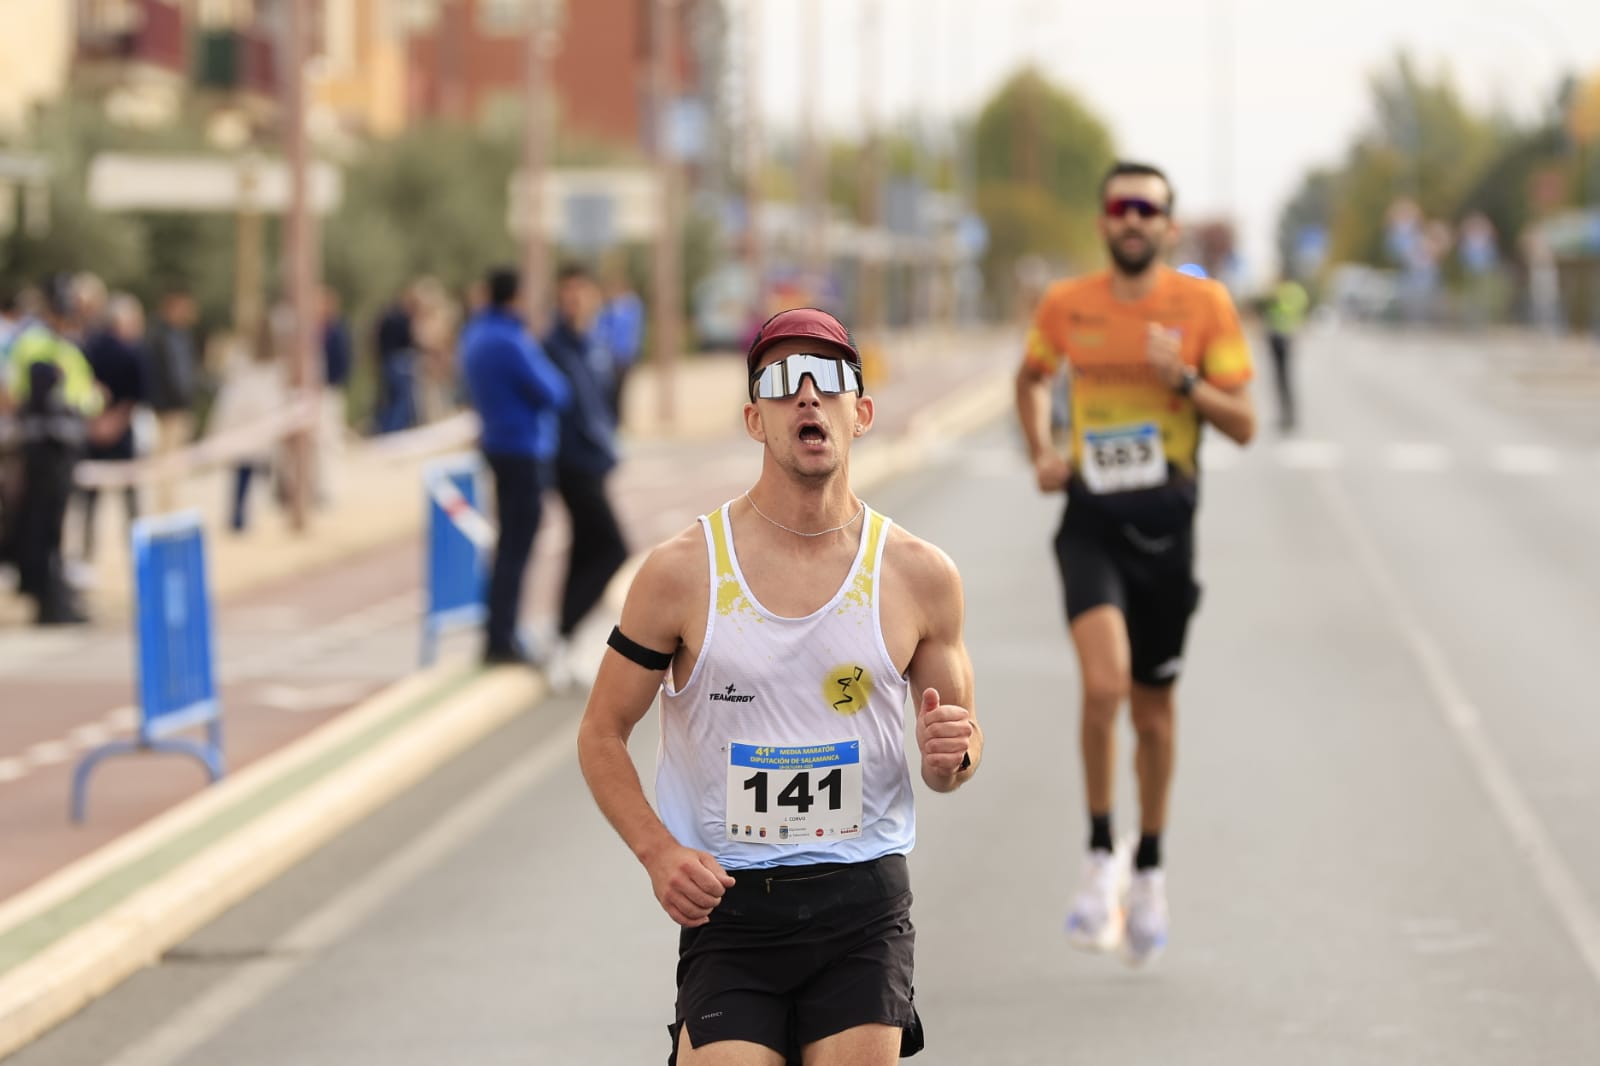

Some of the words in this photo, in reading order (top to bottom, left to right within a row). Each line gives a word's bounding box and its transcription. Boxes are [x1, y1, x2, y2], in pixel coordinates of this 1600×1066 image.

[709, 693, 755, 702] TEAMERGY
[803, 745, 835, 754] MARATÓN
[750, 756, 790, 764] DIPUTACIÓN
[801, 754, 840, 763] SALAMANCA
[743, 768, 842, 813] 141
